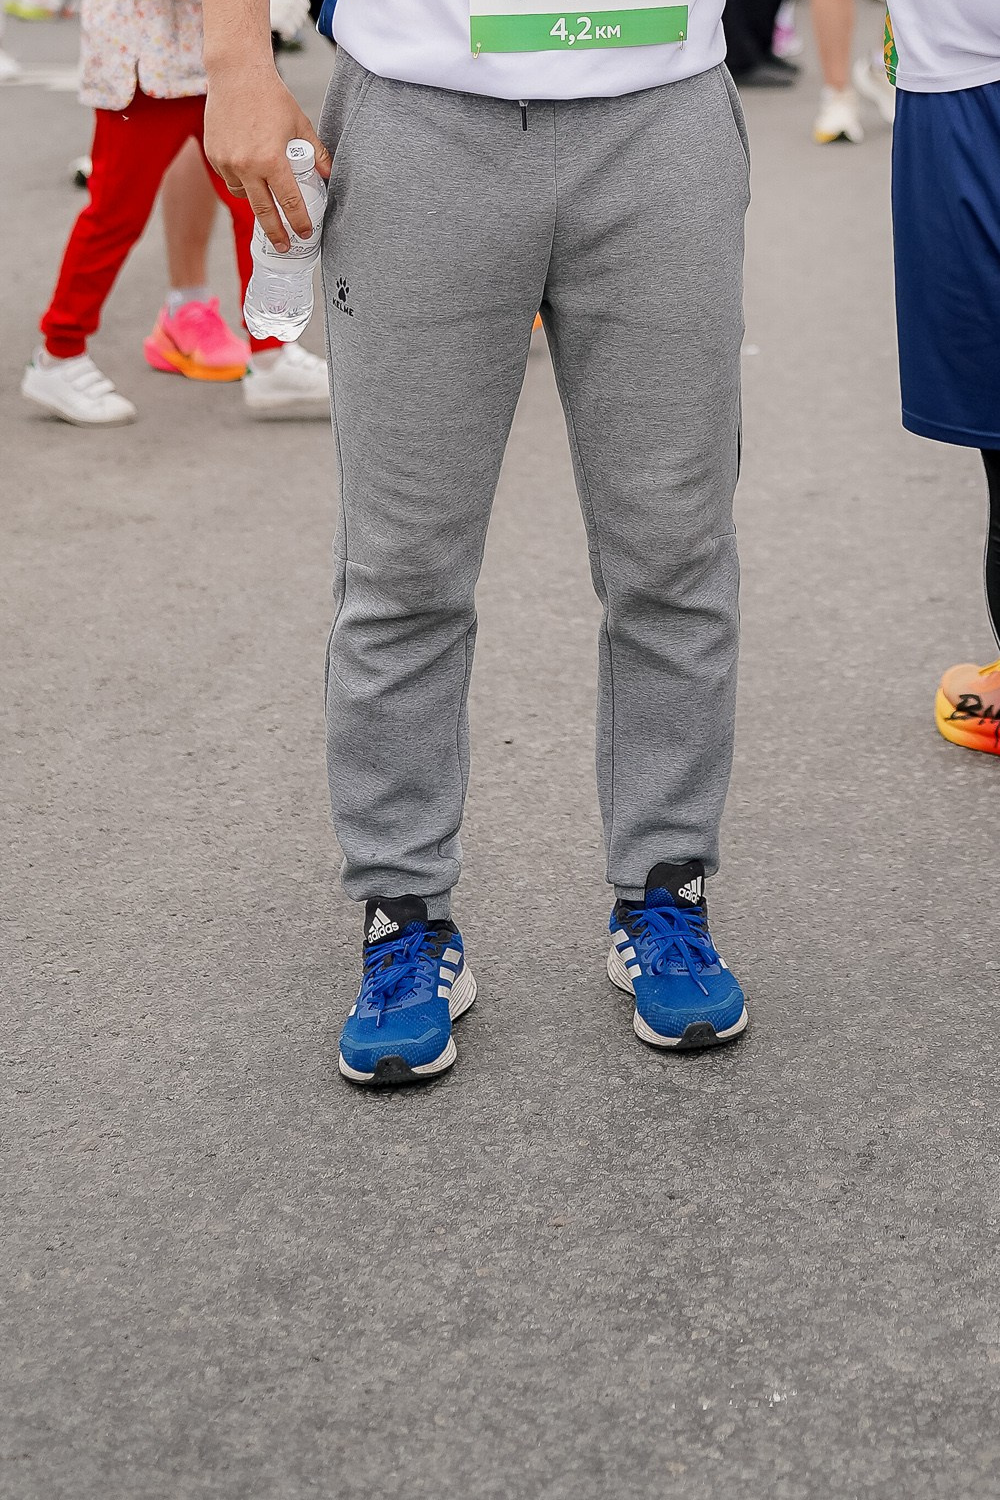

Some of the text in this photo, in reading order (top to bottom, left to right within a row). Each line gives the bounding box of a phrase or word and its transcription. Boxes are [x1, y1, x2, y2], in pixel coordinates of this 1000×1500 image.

[549, 16, 622, 45] 4,2 км
[332, 297, 354, 317] KELME
[678, 887, 700, 905] adid
[367, 921, 399, 944] adidas
